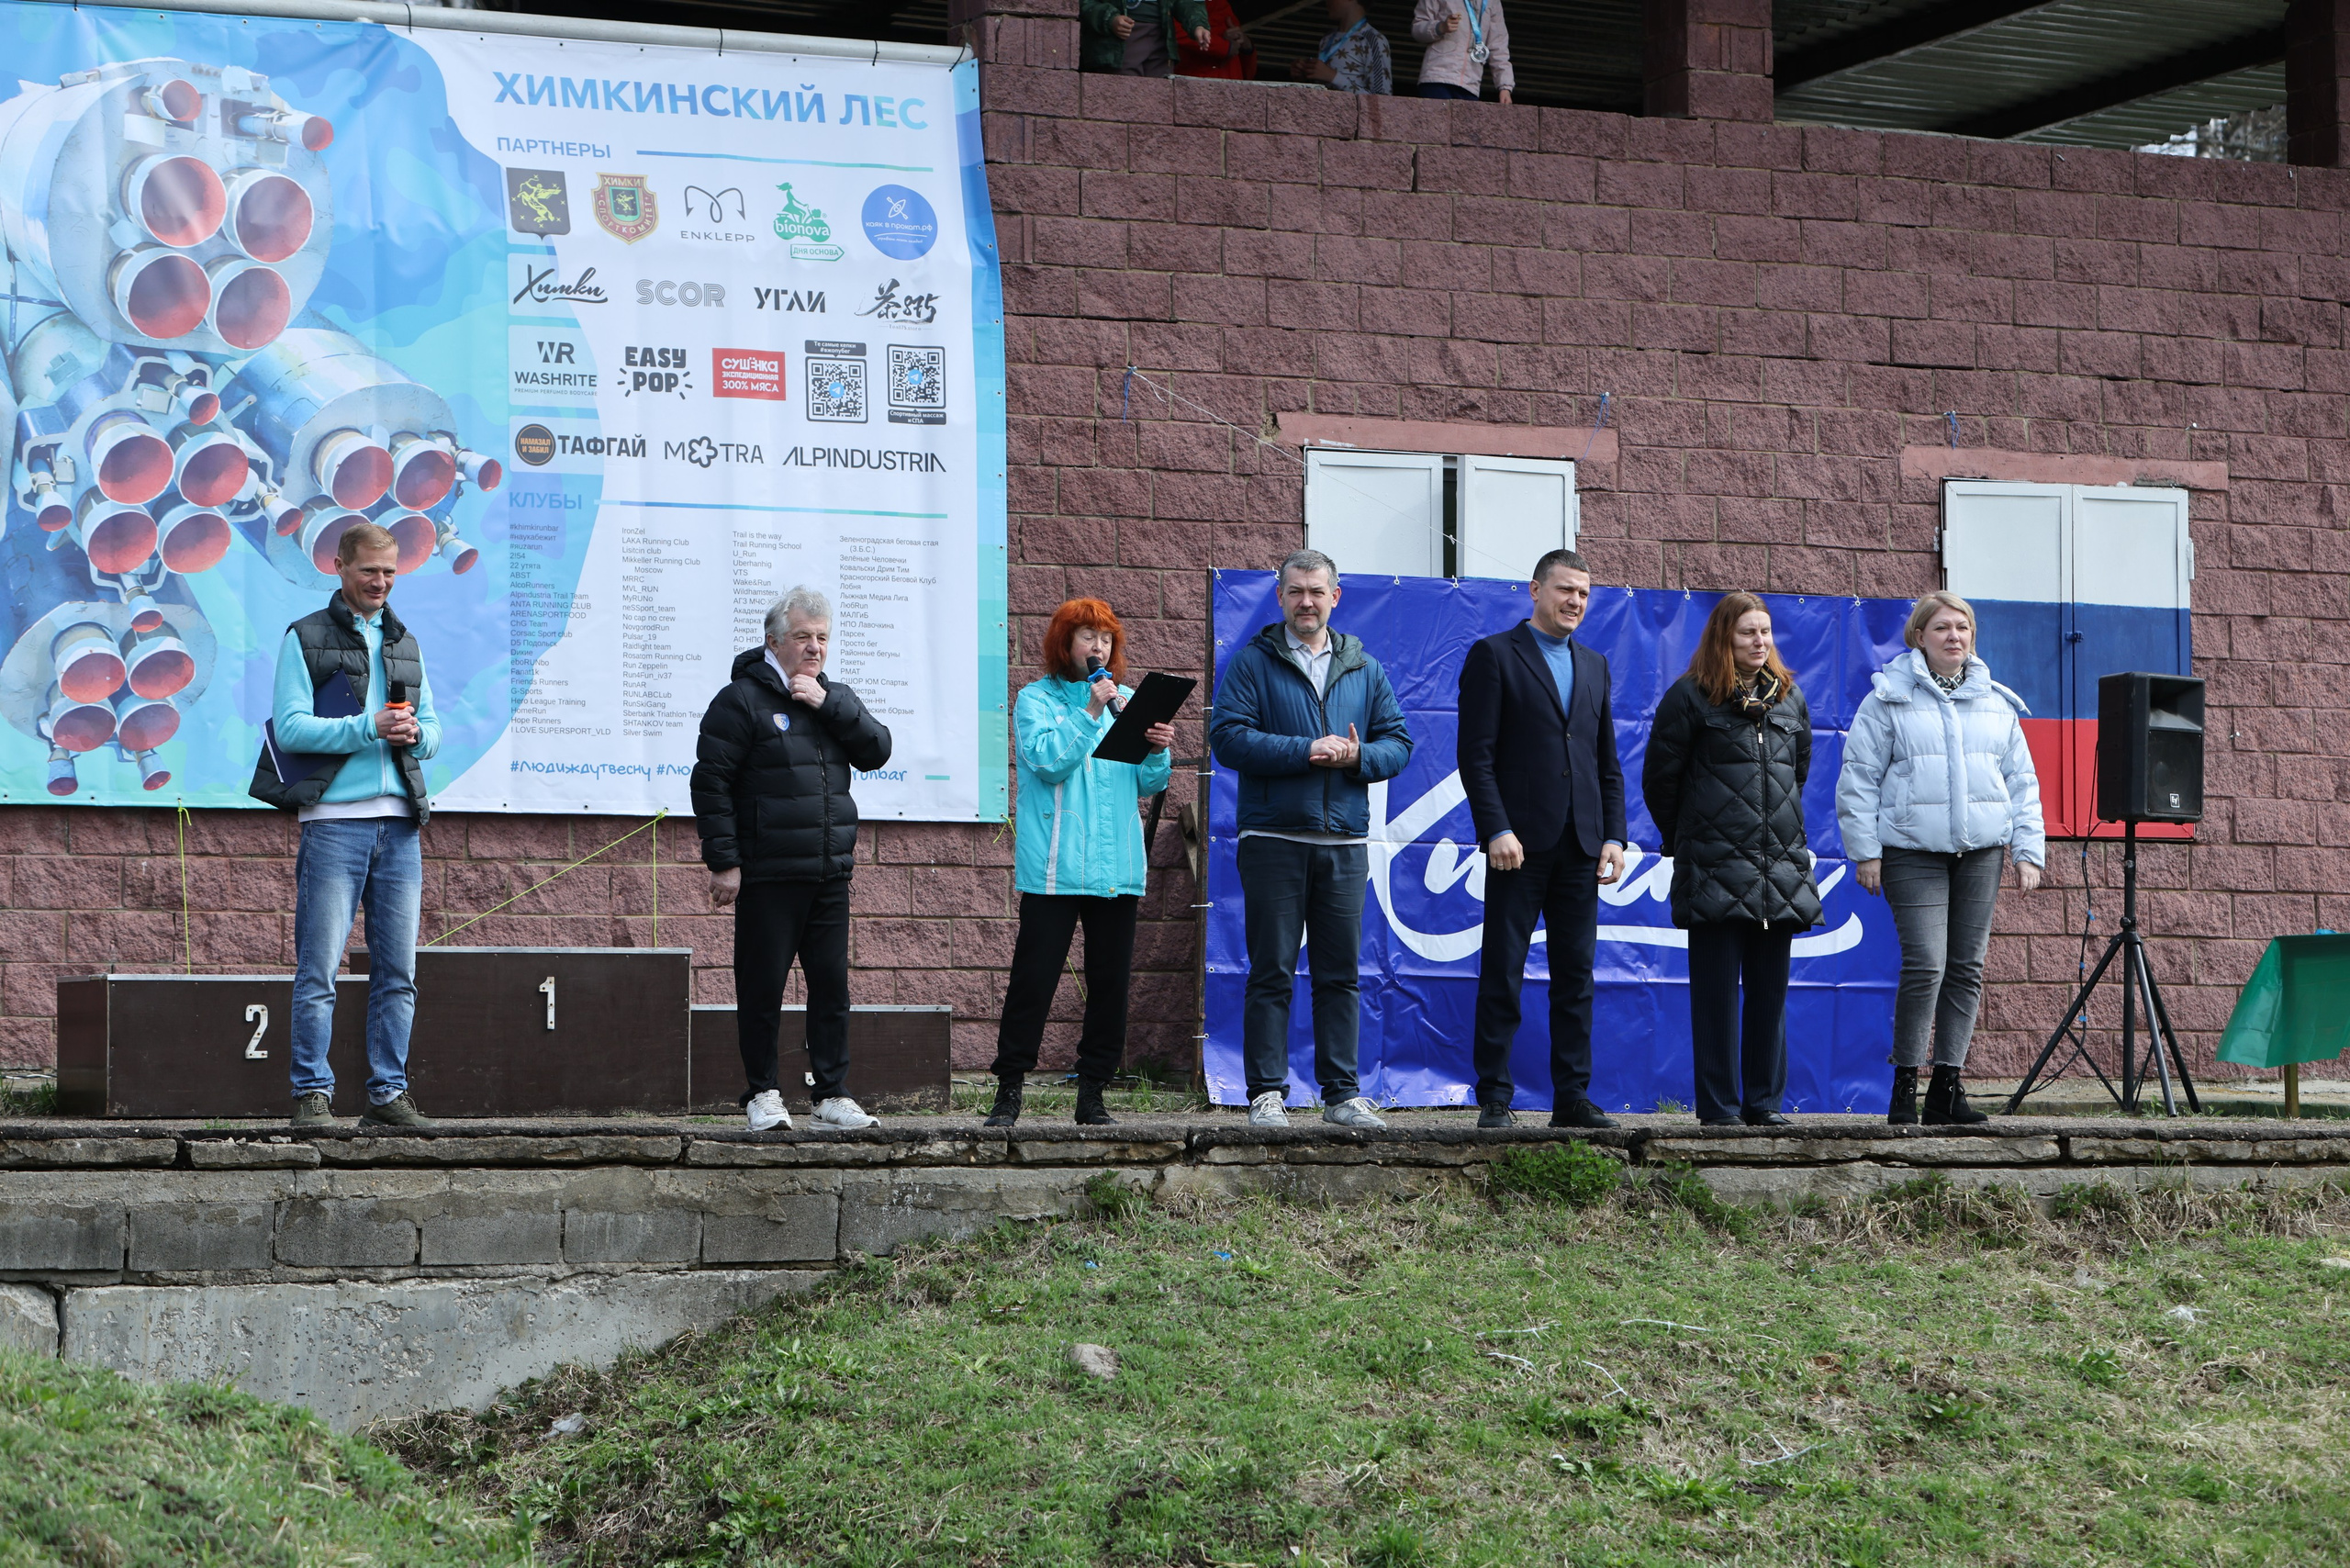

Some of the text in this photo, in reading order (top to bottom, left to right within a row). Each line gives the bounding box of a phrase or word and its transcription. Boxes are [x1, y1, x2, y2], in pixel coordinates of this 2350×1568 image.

[492, 71, 929, 130] ХИМКИНСКИЙ ЛЕС
[497, 137, 611, 159] ПАРТНЕРЫ
[604, 176, 641, 187] ХИМКИ
[598, 199, 653, 234] СПОРТКОМИТЕТ
[775, 219, 830, 236] bionova
[891, 222, 933, 231] прокат.рф
[680, 230, 755, 242] ENKLEPP
[513, 263, 608, 305] Химки
[635, 279, 725, 308] SCOR
[754, 286, 826, 313] УГЛИ
[625, 346, 687, 369] EASY
[722, 357, 778, 373] СУШЁНКА
[514, 371, 597, 387] WASHRITE
[632, 371, 679, 393] POP
[722, 380, 779, 392] 300% МЯСА
[520, 438, 551, 446] НАМАЗАЛ
[557, 433, 646, 457] ТАФГАЙ
[782, 446, 946, 473] ALPINDUSTRIA
[509, 491, 582, 510] КЛУБЫ
[509, 523, 559, 532] #khimkirunbar
[509, 533, 556, 542] #наукабежит
[839, 536, 894, 545] Зеленоградская
[896, 538, 921, 546] беговая
[643, 538, 672, 547] Running
[749, 542, 777, 551] Running
[778, 542, 802, 550] School
[654, 556, 683, 566] Running
[622, 575, 644, 583] MRRC
[839, 574, 936, 586] Красногорский Беговой Клуб
[509, 581, 555, 589] AlcoRunners
[622, 585, 659, 593] MVL_RUN
[509, 591, 551, 599] Alpindustria
[733, 588, 778, 597] Wildhamsters
[868, 593, 892, 601] Медиа
[532, 601, 569, 610] RUNNING
[622, 604, 676, 613] neSSport_team
[510, 610, 587, 619] ARENASPORTFOOD
[622, 623, 670, 632] NovgorodRun
[857, 622, 894, 630] Лавочкина
[537, 630, 556, 639] Sport
[622, 633, 657, 642] Pulsar_19
[523, 640, 557, 648] Подольск
[622, 643, 652, 651] Raidlight
[841, 639, 865, 647] Просто
[655, 653, 683, 661] Running
[841, 648, 901, 659] Районные бегуны
[638, 662, 668, 670] Zeppelin
[622, 671, 672, 680] Run4Fun_iv37
[510, 688, 543, 696] G-Sports
[531, 698, 556, 707] League
[558, 699, 586, 707] Training
[622, 700, 666, 709] RunSkiGang
[656, 710, 687, 718] Triathlon
[511, 717, 562, 725] Hope Runners
[538, 727, 611, 736] SUPERSPORT_VLD
[539, 977, 554, 1029] 1
[245, 1004, 268, 1058] 2
